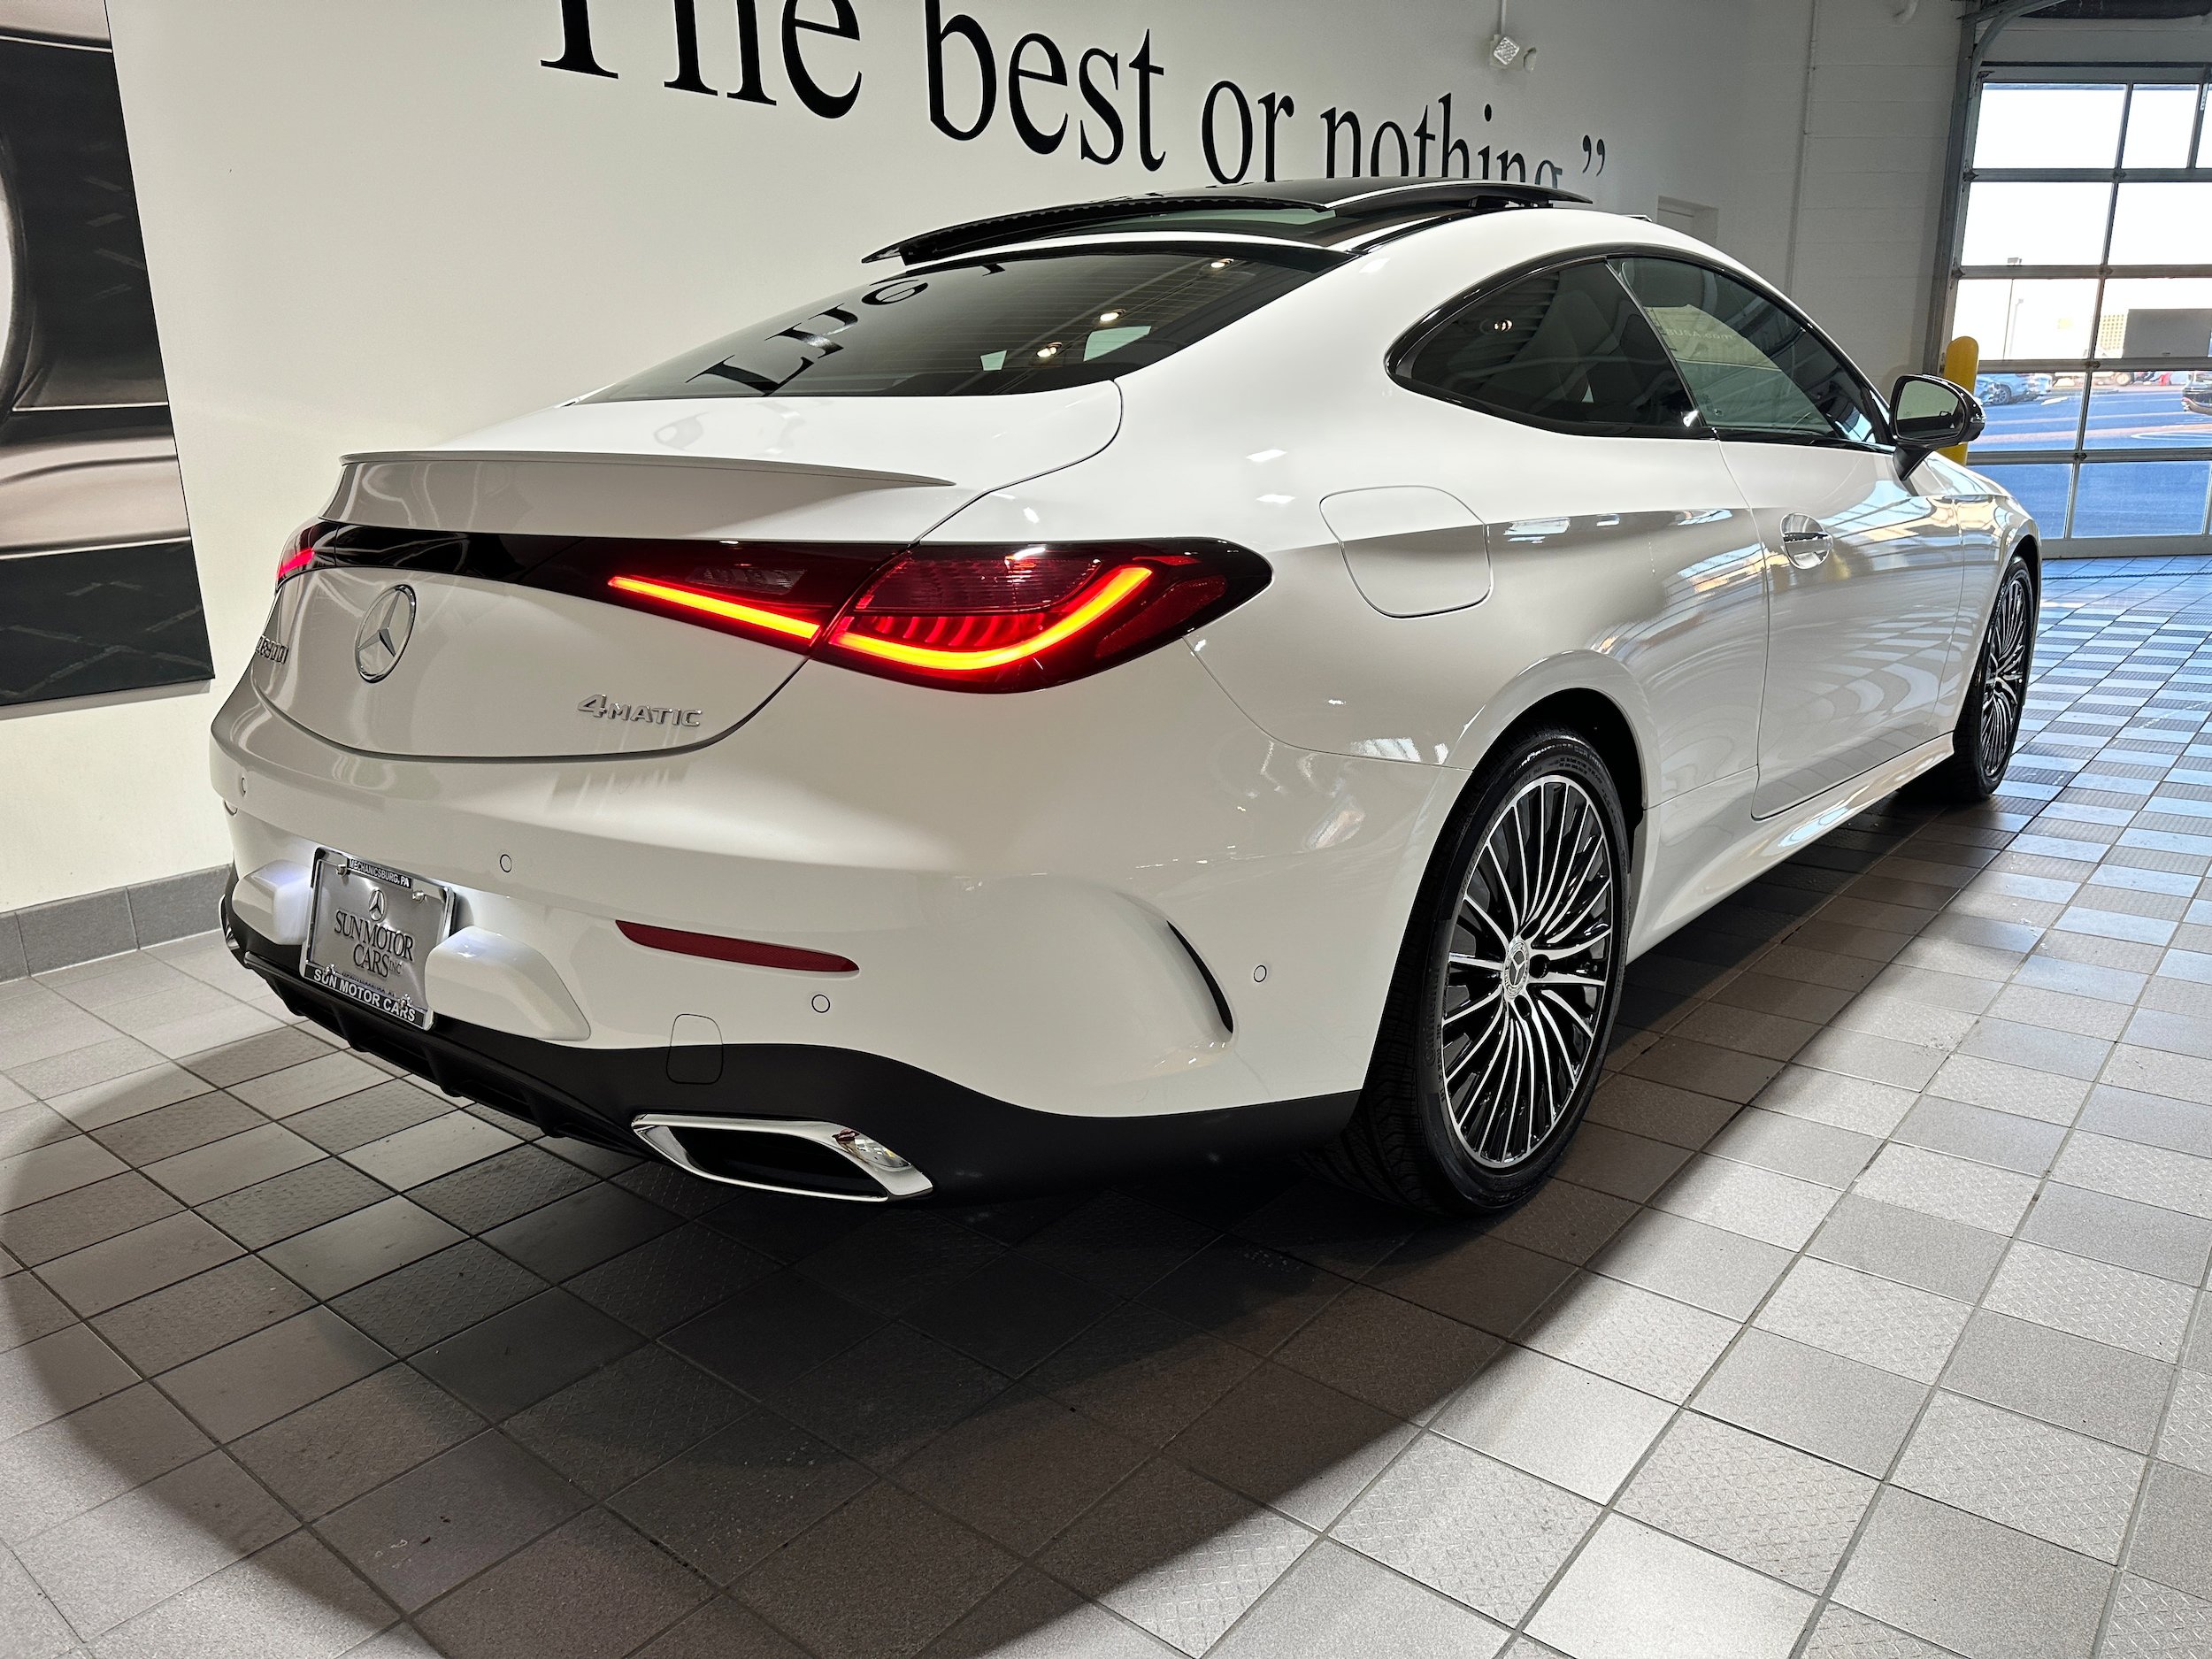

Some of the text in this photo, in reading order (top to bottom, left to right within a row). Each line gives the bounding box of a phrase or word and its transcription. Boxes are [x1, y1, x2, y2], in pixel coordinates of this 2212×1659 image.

[925, 0, 1166, 172] best
[1201, 81, 1294, 184] or
[577, 694, 703, 727] 4MATIC
[401, 876, 411, 887] PA
[334, 909, 414, 963] SUN MOTOR
[353, 943, 389, 978] CARS
[313, 969, 337, 988] SUN
[339, 979, 380, 1008] MOTOR
[383, 997, 416, 1023] CARS
